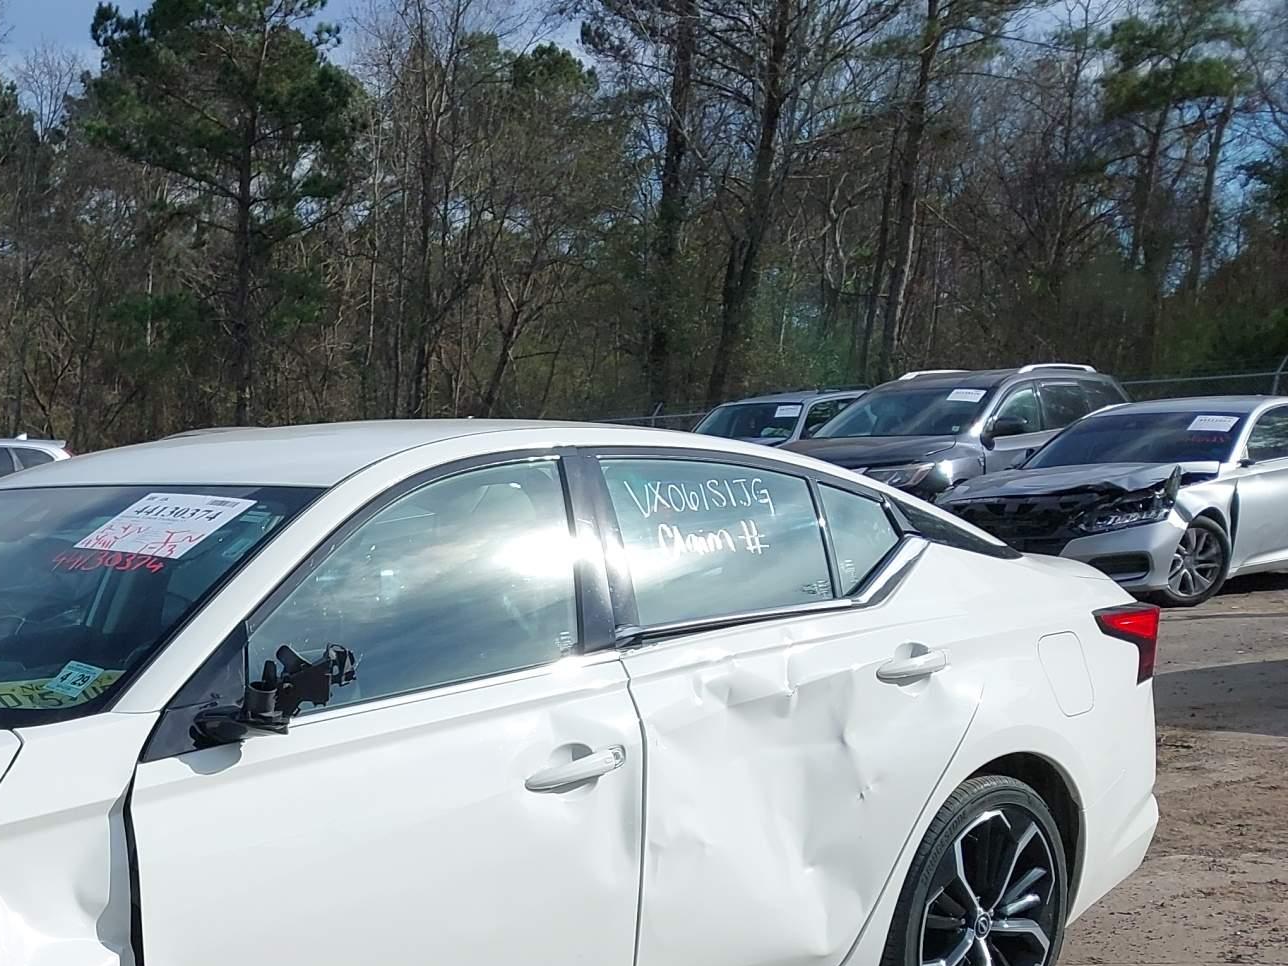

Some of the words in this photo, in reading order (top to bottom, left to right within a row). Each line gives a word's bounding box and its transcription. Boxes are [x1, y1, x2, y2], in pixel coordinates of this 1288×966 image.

[133, 504, 223, 522] 44130374
[656, 522, 737, 558] Claim
[738, 519, 770, 555] #
[70, 673, 91, 687] 29
